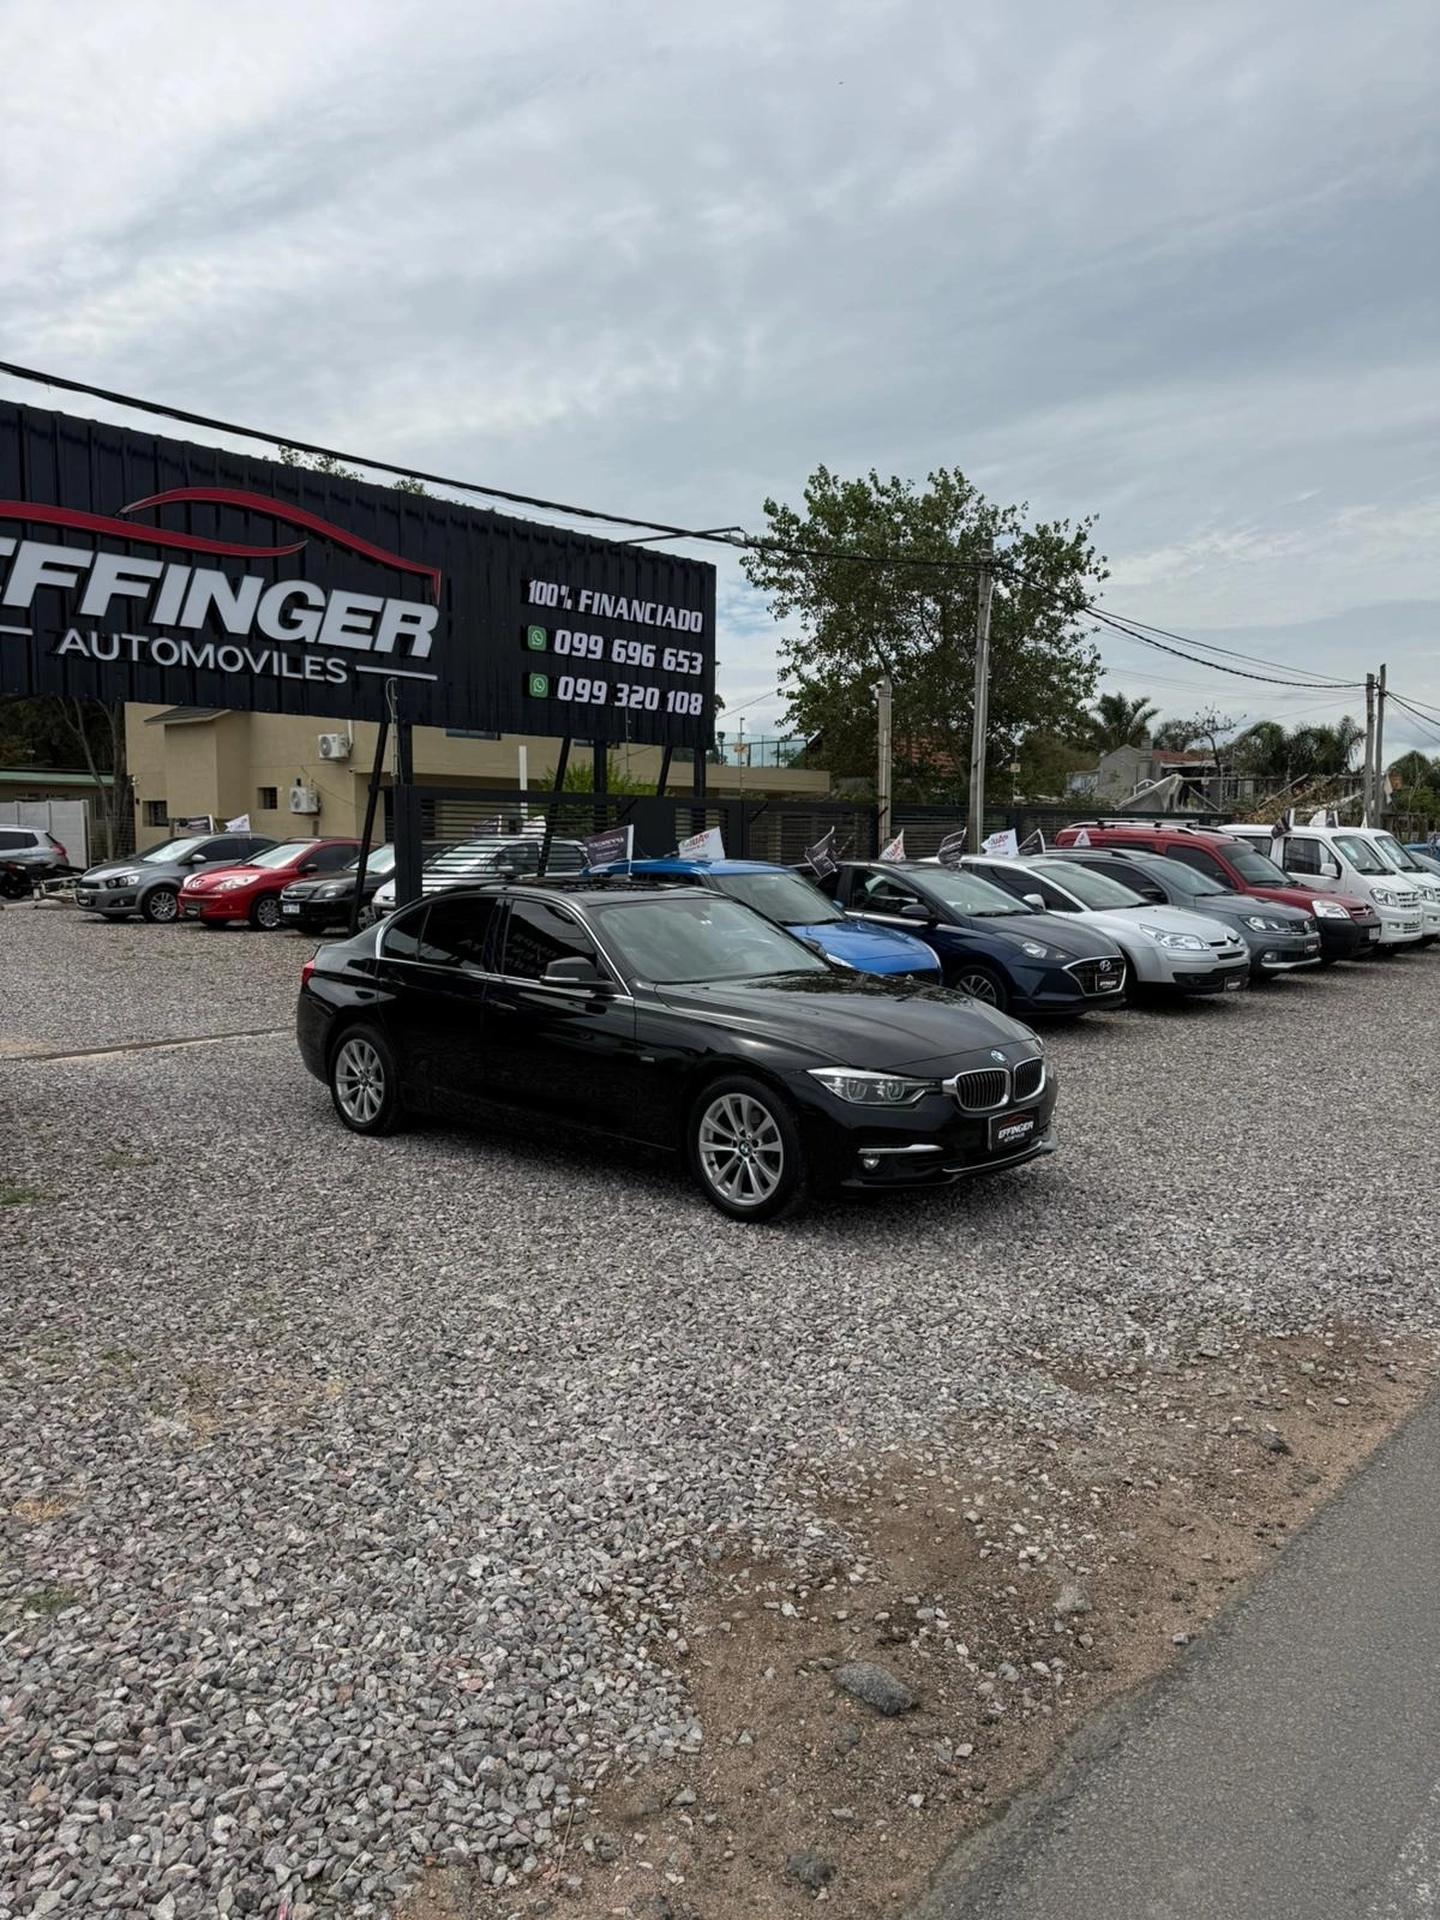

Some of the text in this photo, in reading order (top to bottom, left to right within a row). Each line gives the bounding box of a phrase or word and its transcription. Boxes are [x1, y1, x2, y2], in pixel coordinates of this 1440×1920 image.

[0, 537, 440, 658] FFINGER
[528, 580, 703, 633] 100% FINANCIADO
[58, 628, 348, 684] AUTOMOVILES
[554, 629, 703, 675] 099 696 653
[557, 676, 703, 716] 099 320 108
